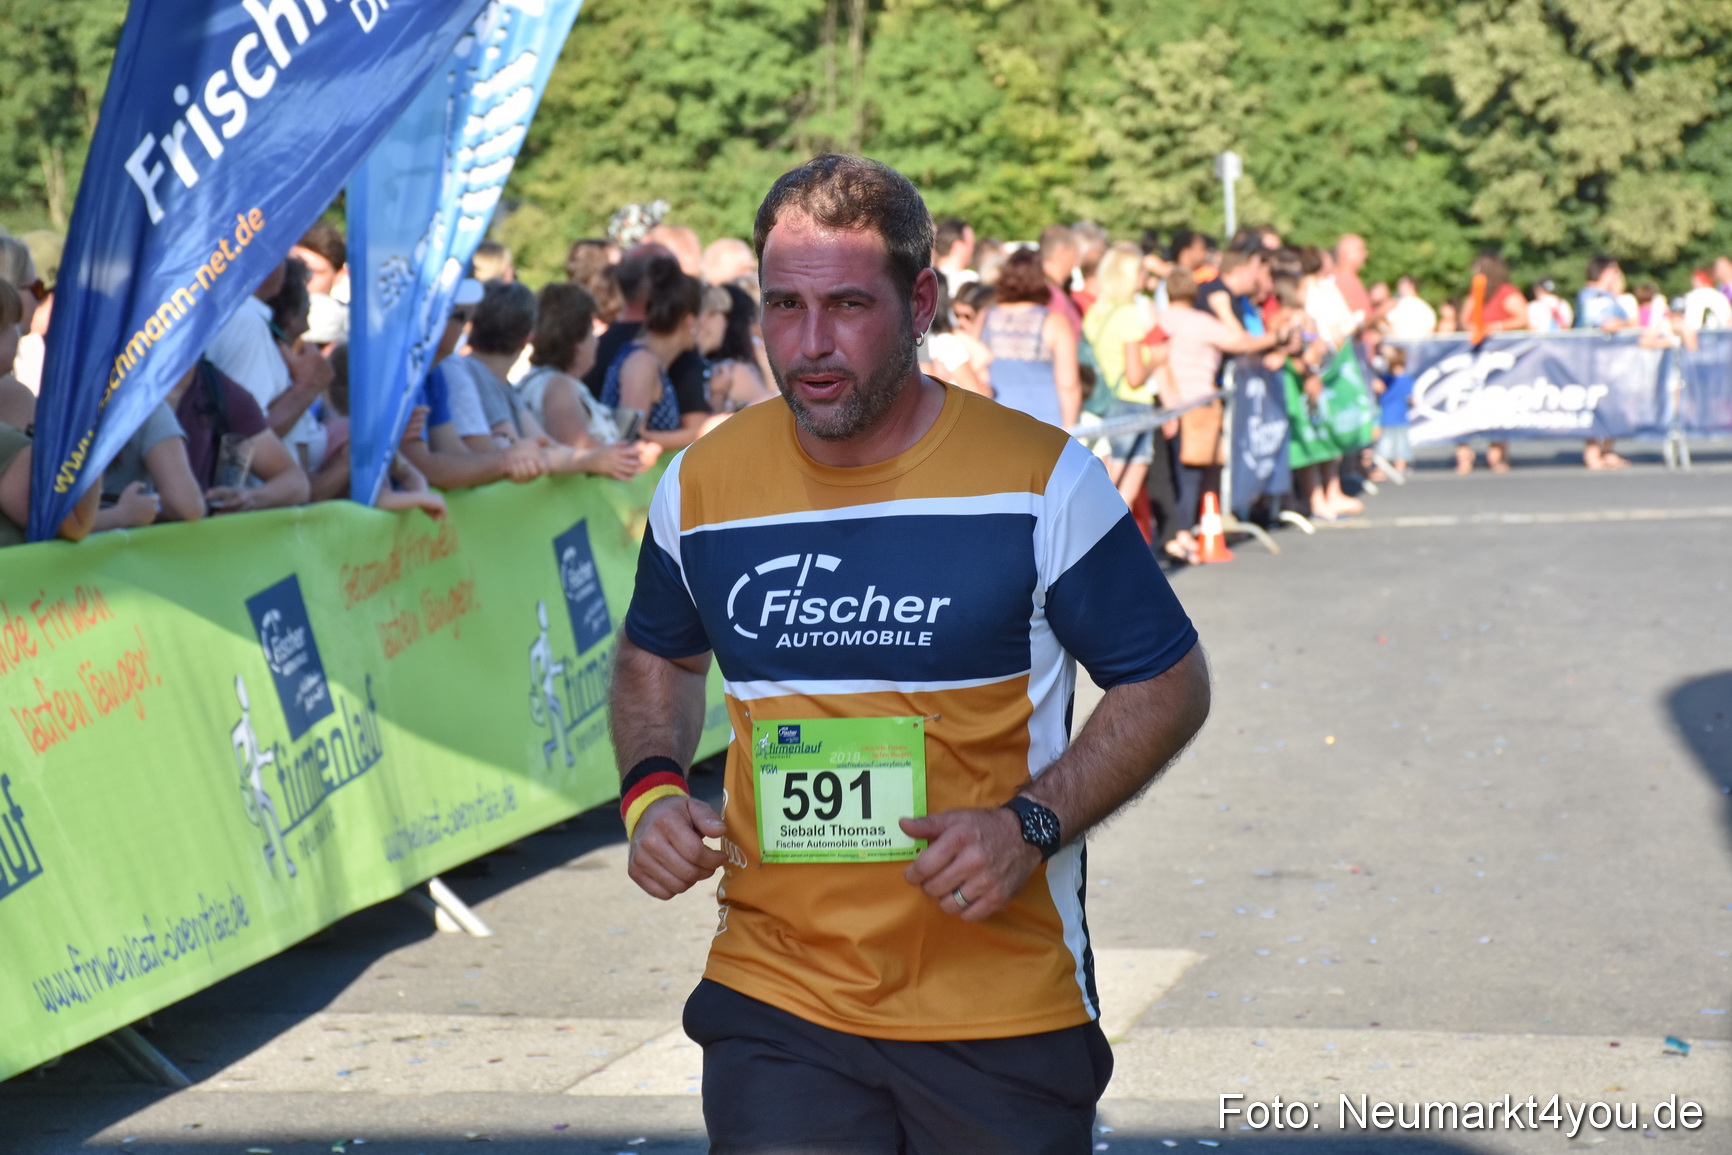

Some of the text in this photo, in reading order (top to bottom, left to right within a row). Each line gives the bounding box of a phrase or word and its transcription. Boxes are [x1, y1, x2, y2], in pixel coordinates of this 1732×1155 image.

[760, 585, 951, 627] Fischer
[775, 630, 933, 649] AUTOMOBILE
[769, 741, 823, 754] firmenlauf
[829, 751, 860, 764] 2018
[782, 770, 872, 821] 591
[780, 823, 886, 837] Siebald Thomas
[776, 838, 892, 849] Fischer Automobile GmbH
